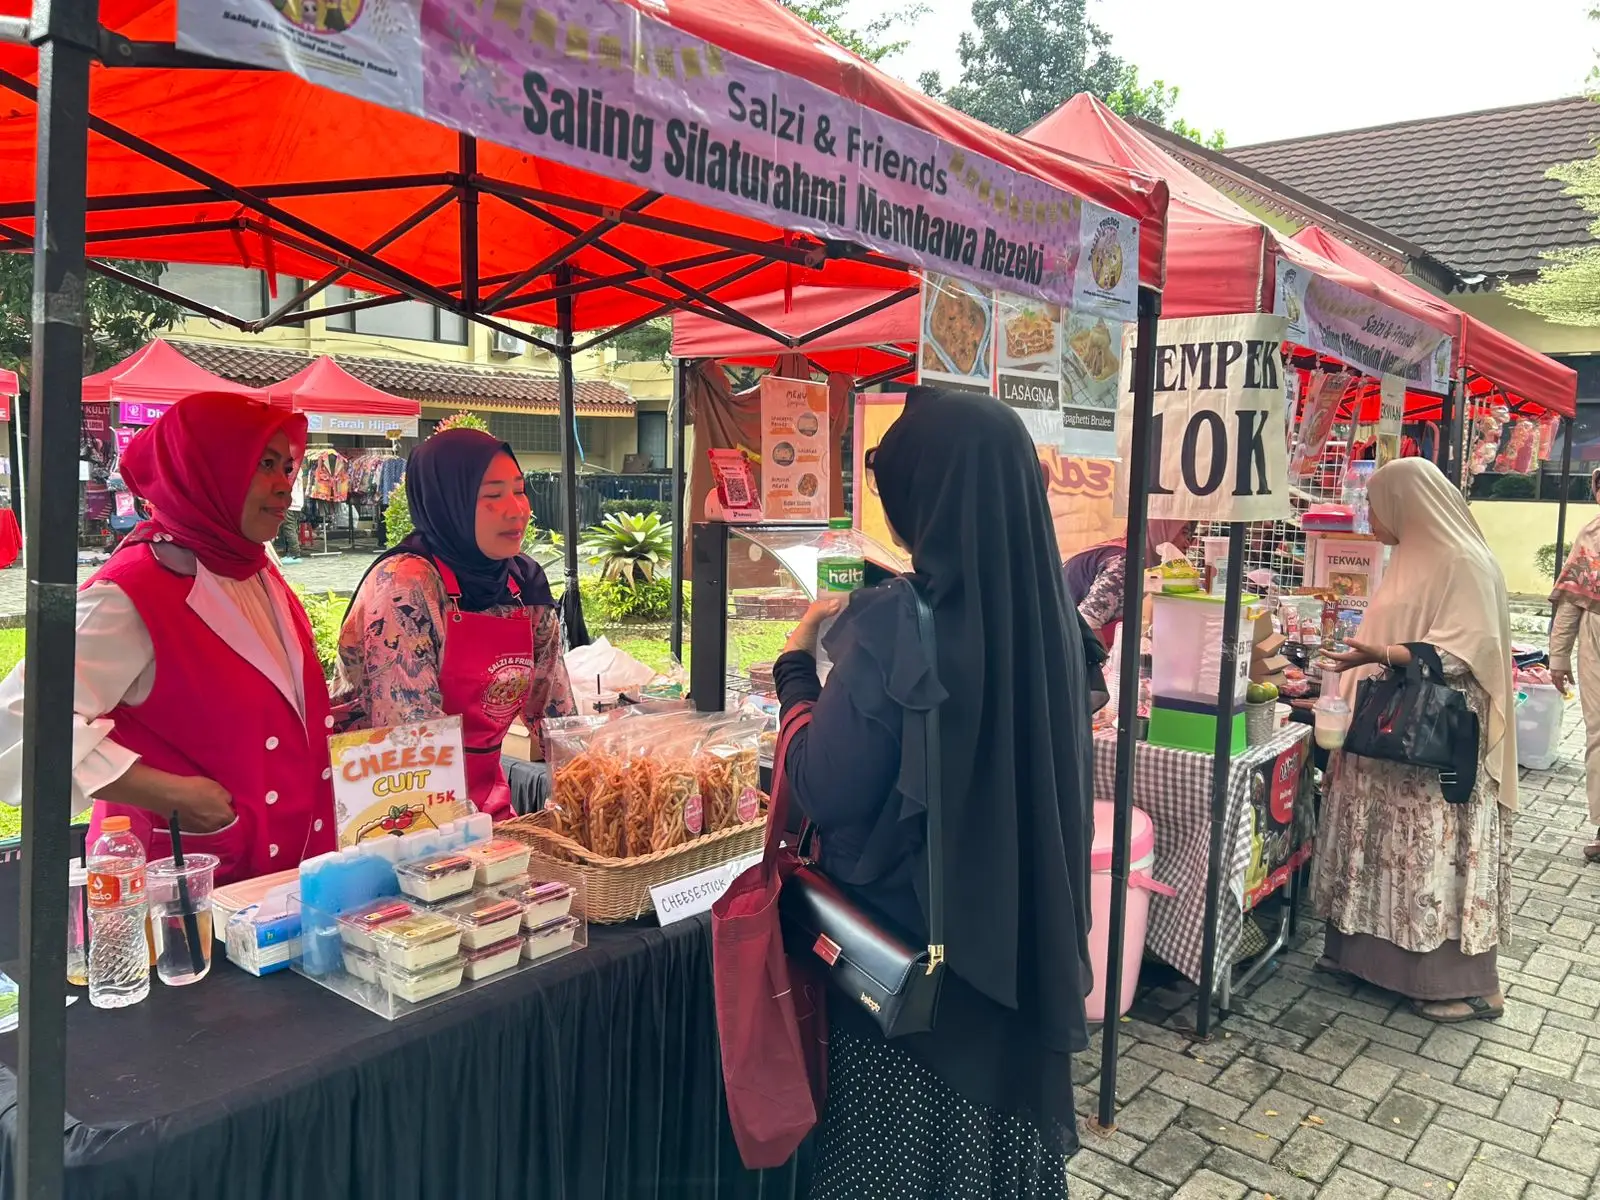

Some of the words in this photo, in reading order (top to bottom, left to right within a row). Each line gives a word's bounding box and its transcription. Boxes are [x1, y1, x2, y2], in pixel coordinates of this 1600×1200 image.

[728, 81, 805, 145] Salzi
[814, 114, 837, 157] &
[846, 126, 948, 196] Friends
[523, 70, 654, 173] Saling
[664, 118, 846, 227] Silaturahmi
[855, 183, 978, 266] Membawa
[980, 226, 1044, 286] Rezeki
[1361, 314, 1387, 337] Salzi
[1128, 340, 1279, 393] EMPEK
[1004, 384, 1055, 404] LASAGNA
[329, 418, 364, 429] Farah
[368, 420, 399, 432] Hijab
[1091, 415, 1112, 427] Brulee
[1148, 410, 1272, 496] 10K
[1327, 555, 1370, 566] TEKWAN
[487, 658, 507, 674] SALZI
[508, 657, 514, 665] &
[342, 746, 454, 782] CHEESE
[372, 769, 431, 796] CUIT
[426, 790, 456, 808] 15K
